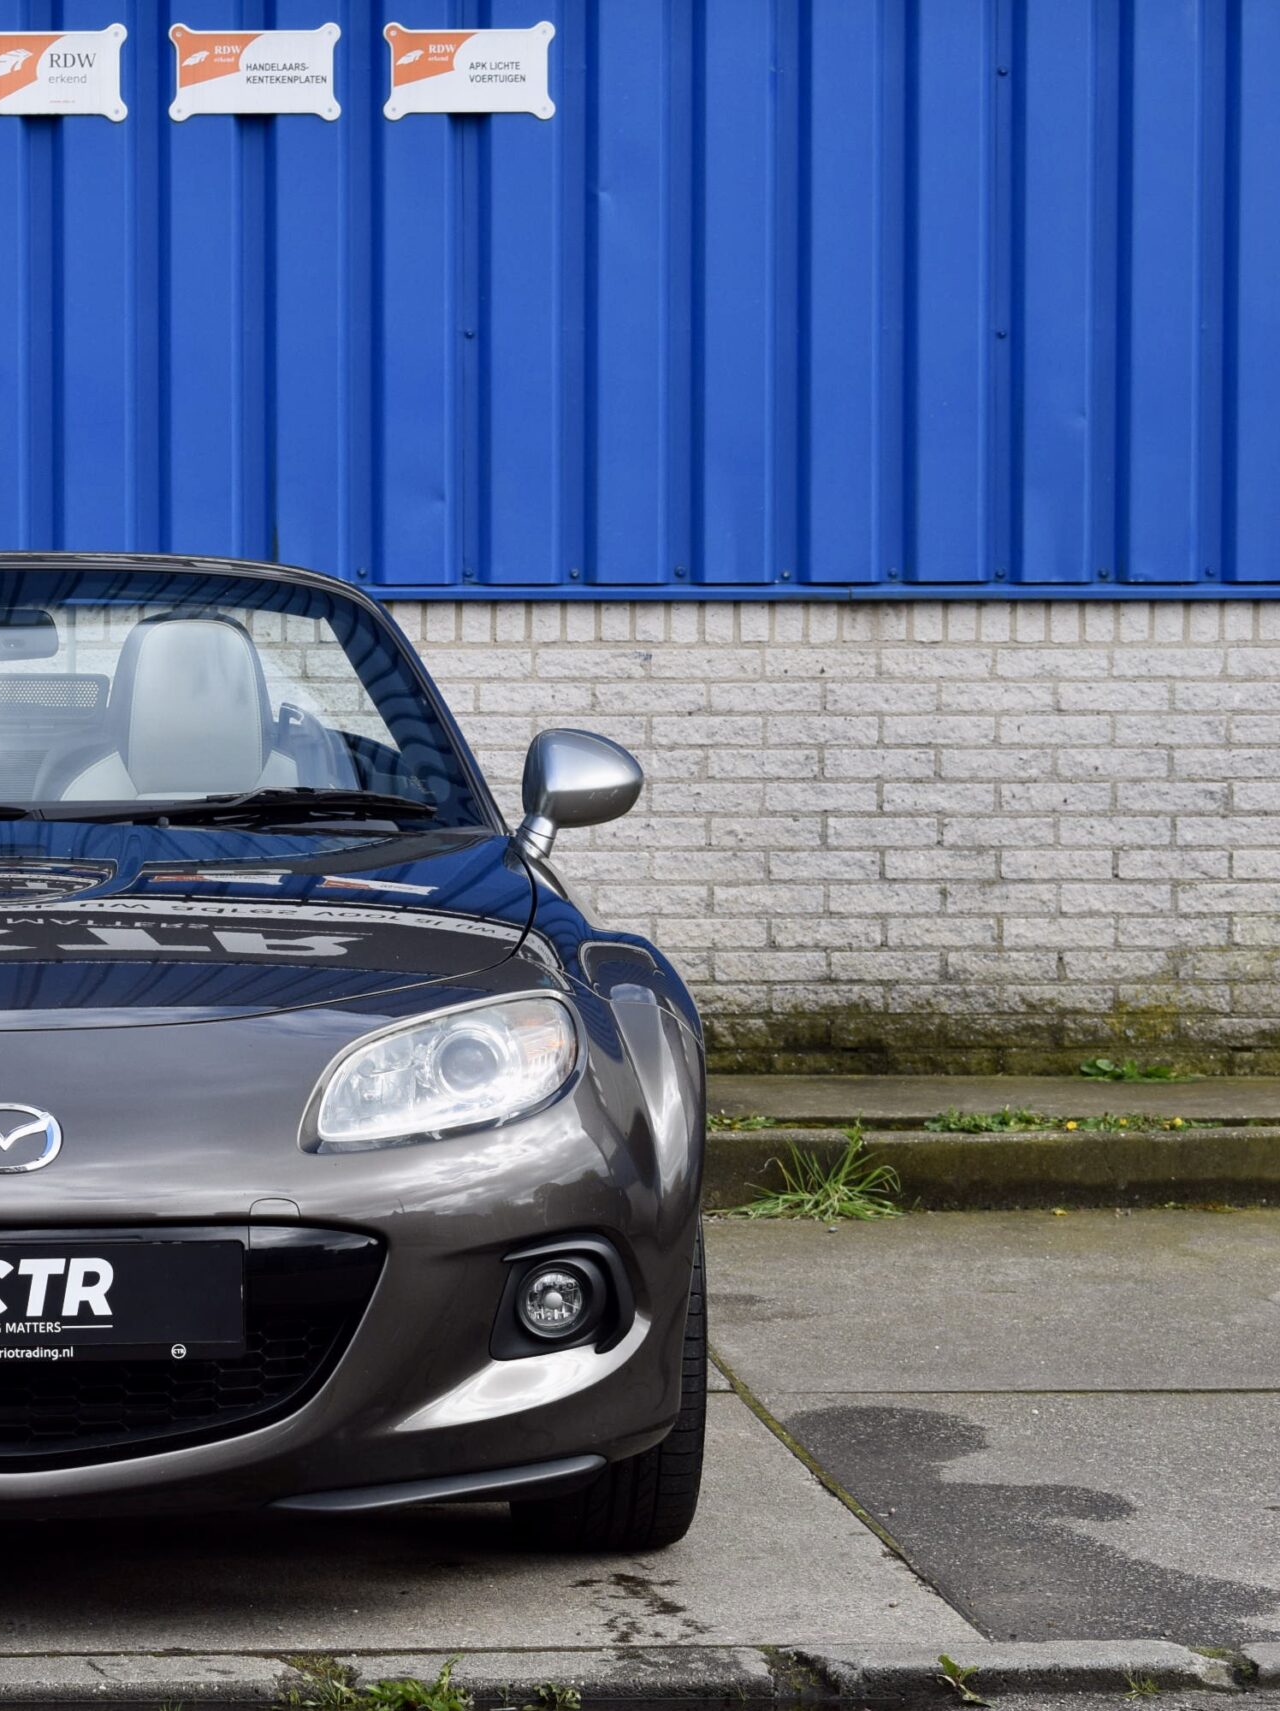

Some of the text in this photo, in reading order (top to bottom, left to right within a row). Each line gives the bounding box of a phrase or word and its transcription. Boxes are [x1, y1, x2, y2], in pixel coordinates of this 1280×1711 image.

[214, 45, 241, 55] RDW
[428, 44, 456, 54] RDW
[48, 53, 96, 69] RDW
[469, 61, 520, 70] APK LICHTE
[246, 62, 309, 71] HANDELAARS-
[48, 74, 87, 84] erkend
[246, 75, 327, 84] KENTEKENPLATEN
[469, 74, 526, 83] VOERTUIGEN
[5, 1321, 61, 1334] MATTERS
